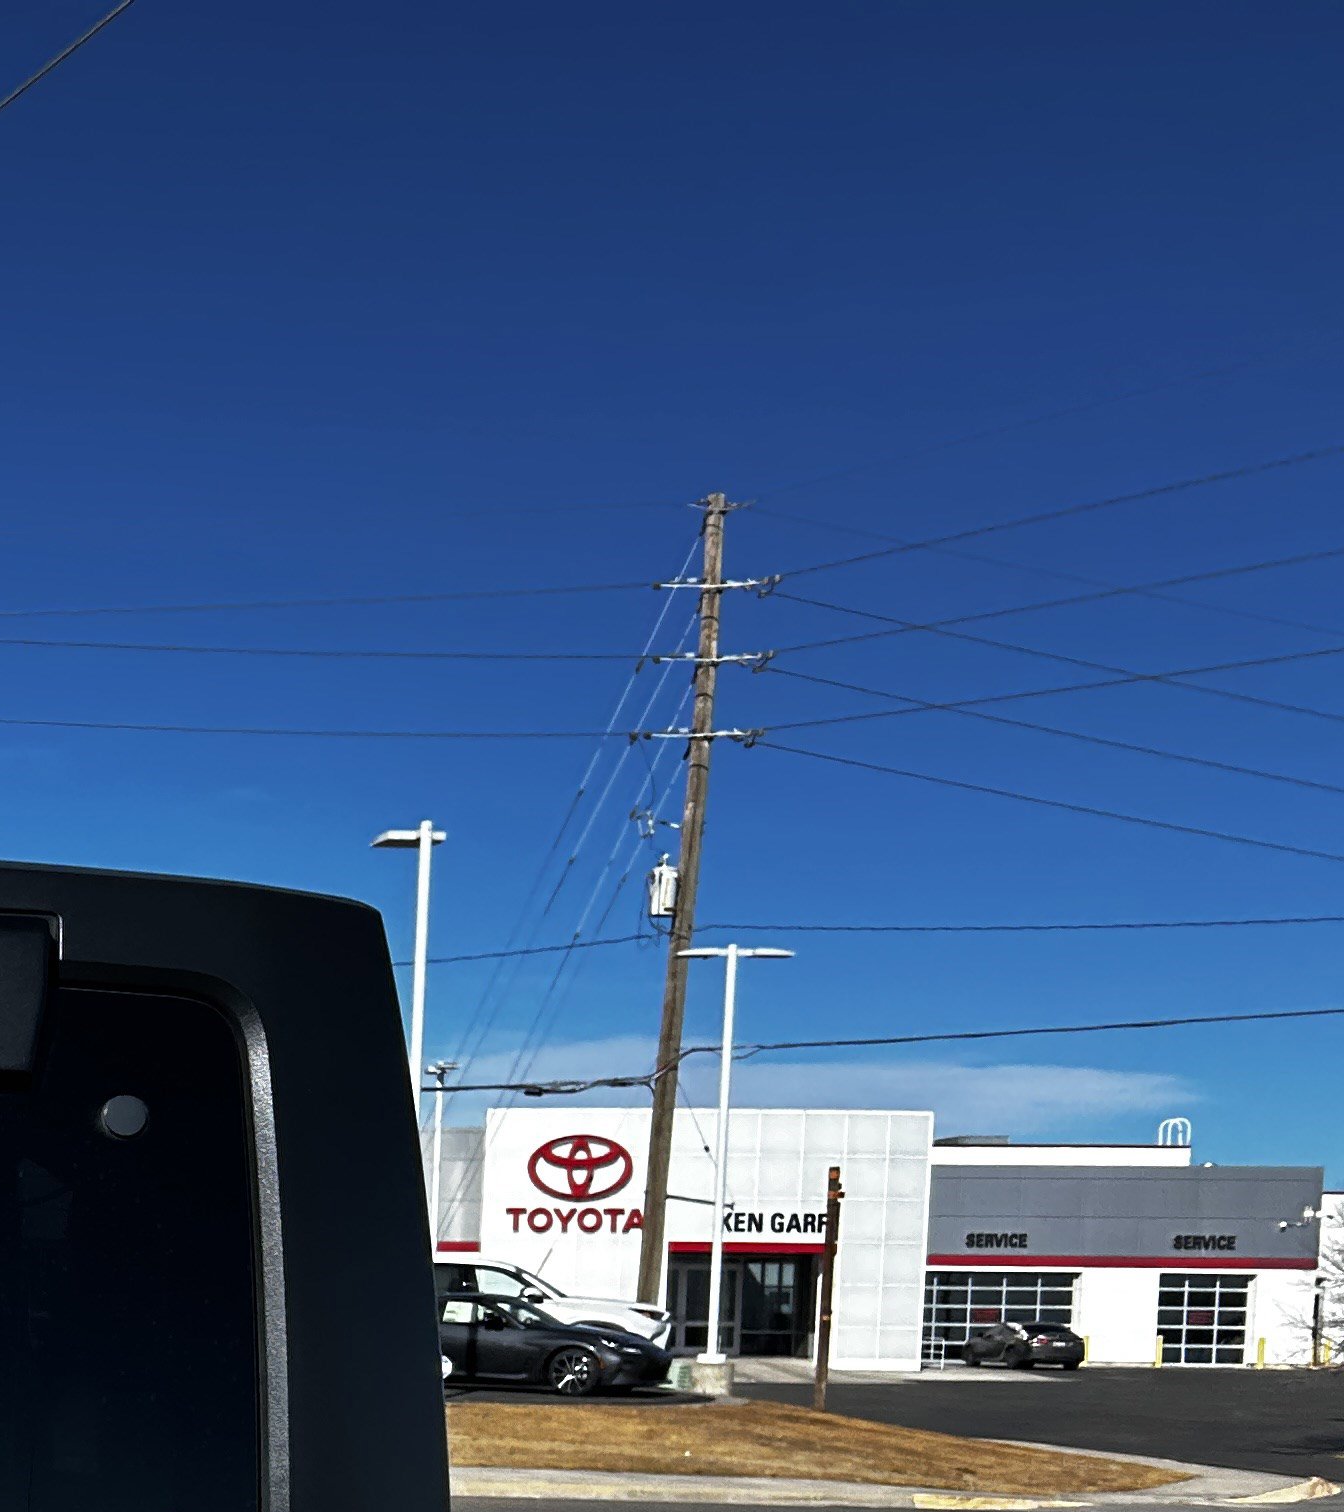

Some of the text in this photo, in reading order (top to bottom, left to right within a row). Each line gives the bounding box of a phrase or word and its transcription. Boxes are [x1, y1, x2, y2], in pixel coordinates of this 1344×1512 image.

[505, 1207, 644, 1234] TOYOTA
[965, 1232, 1028, 1249] SERVICE
[1173, 1234, 1237, 1251] SERVICE
